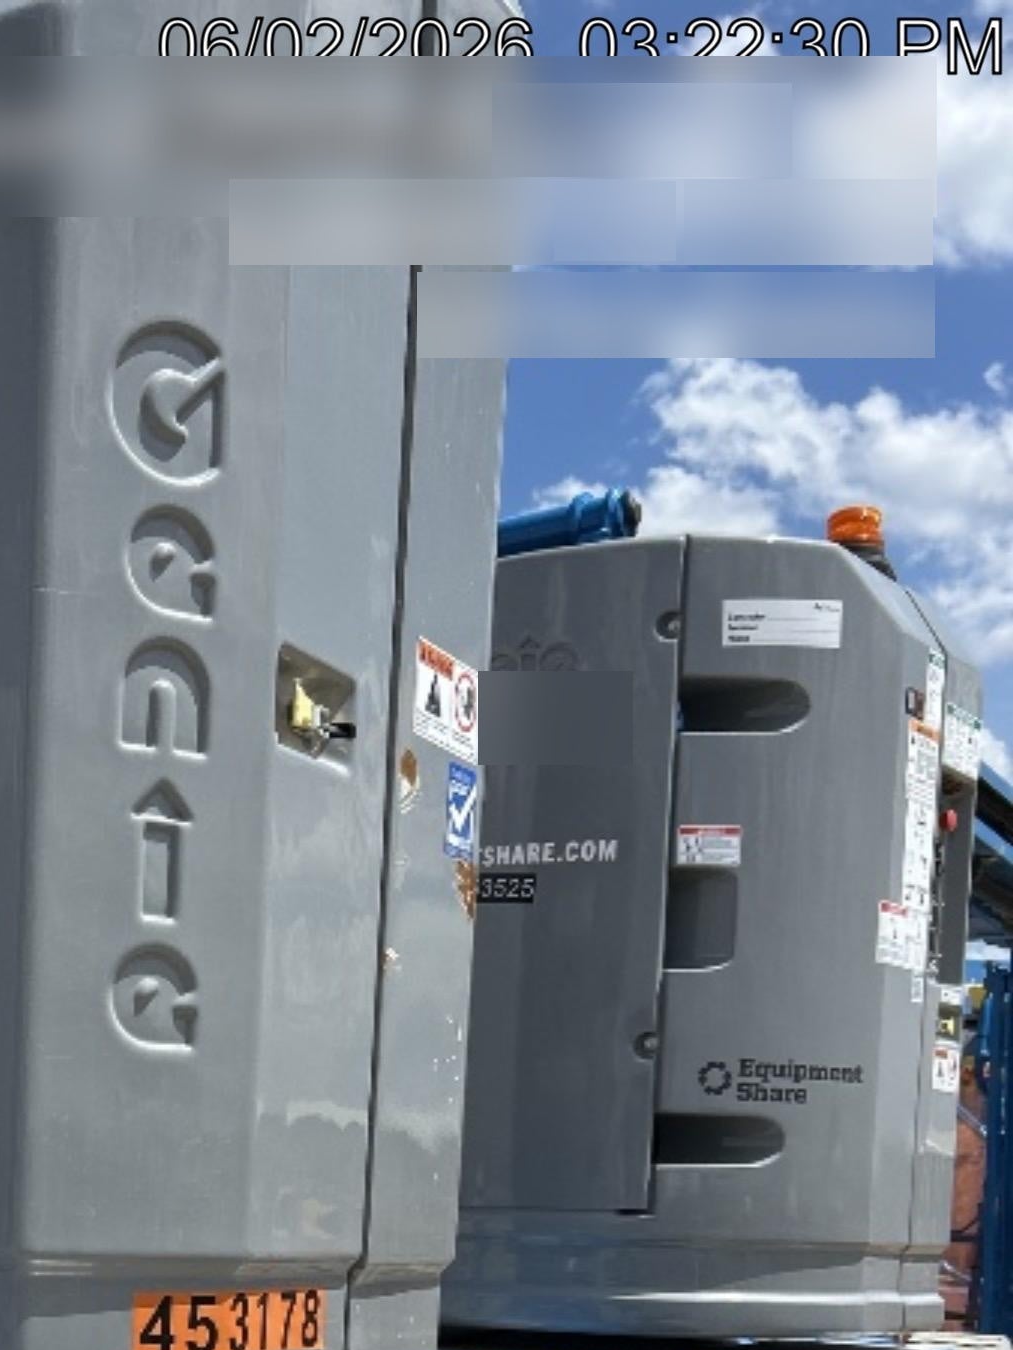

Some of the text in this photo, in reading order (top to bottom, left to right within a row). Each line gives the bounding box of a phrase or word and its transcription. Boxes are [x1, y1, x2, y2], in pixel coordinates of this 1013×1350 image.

[479, 839, 618, 867] SHARE.COM
[477, 878, 535, 899] 3525
[738, 1058, 864, 1084] Equipment
[737, 1082, 808, 1104] Share
